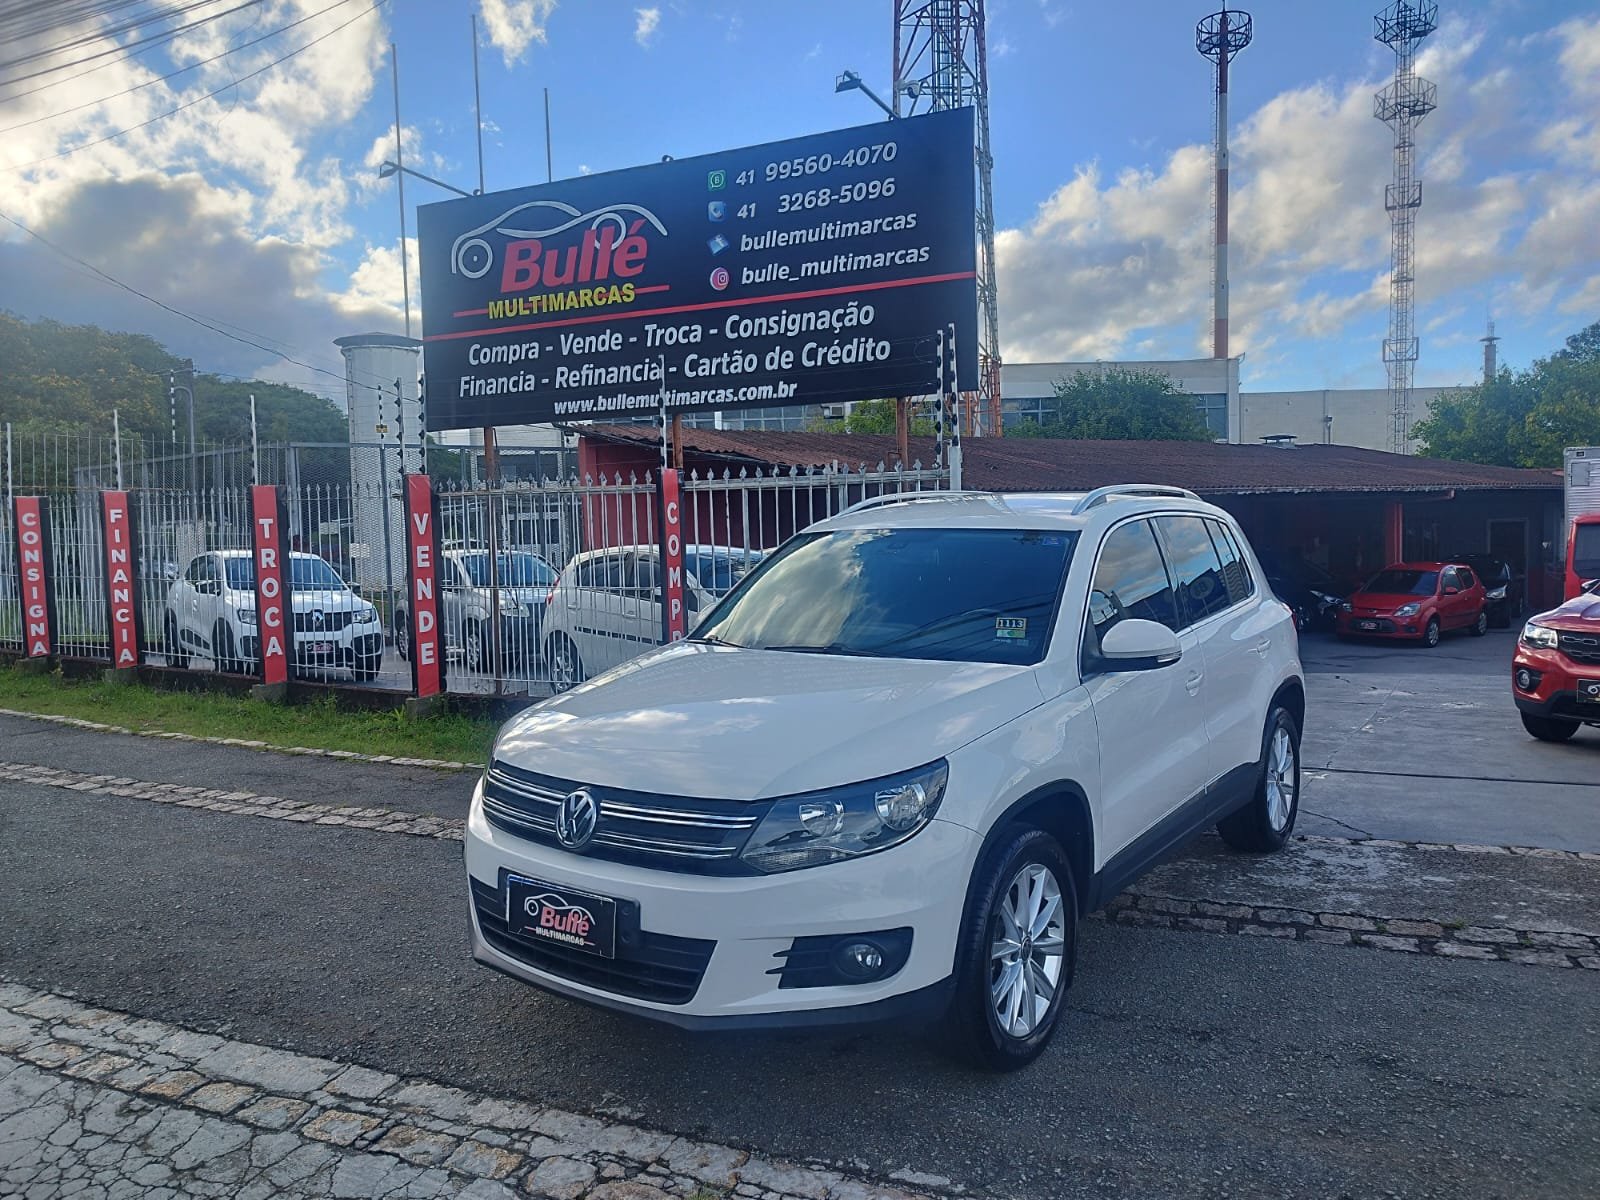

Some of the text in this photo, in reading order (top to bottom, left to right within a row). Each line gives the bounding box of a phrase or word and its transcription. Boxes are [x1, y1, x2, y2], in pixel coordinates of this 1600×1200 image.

[736, 142, 897, 186] 41 99560-4070
[737, 177, 896, 219] 41 3268-5096
[740, 212, 917, 252] bullemultimarcas
[500, 218, 648, 293] Bullé
[741, 246, 930, 285] bulle_multimarcas
[488, 282, 635, 320] MULTIMARCAS
[469, 341, 539, 366] Compra
[560, 329, 623, 356] Vende
[644, 323, 702, 347] Troca
[725, 301, 875, 339] Consignação
[459, 370, 535, 398] Financia
[555, 358, 661, 389] Refinancia
[684, 349, 758, 378] Cartão
[765, 346, 794, 371] de
[801, 337, 891, 368] Crédito
[554, 381, 798, 415] www.bullemutimarcas.com.br
[22, 512, 48, 655] CONSIGNA
[109, 509, 134, 663] FINANCIA
[258, 518, 283, 657] TROCA
[413, 512, 436, 666] VENDE
[535, 926, 585, 946] MULTIMARCAS
[540, 906, 589, 937] Bullé
